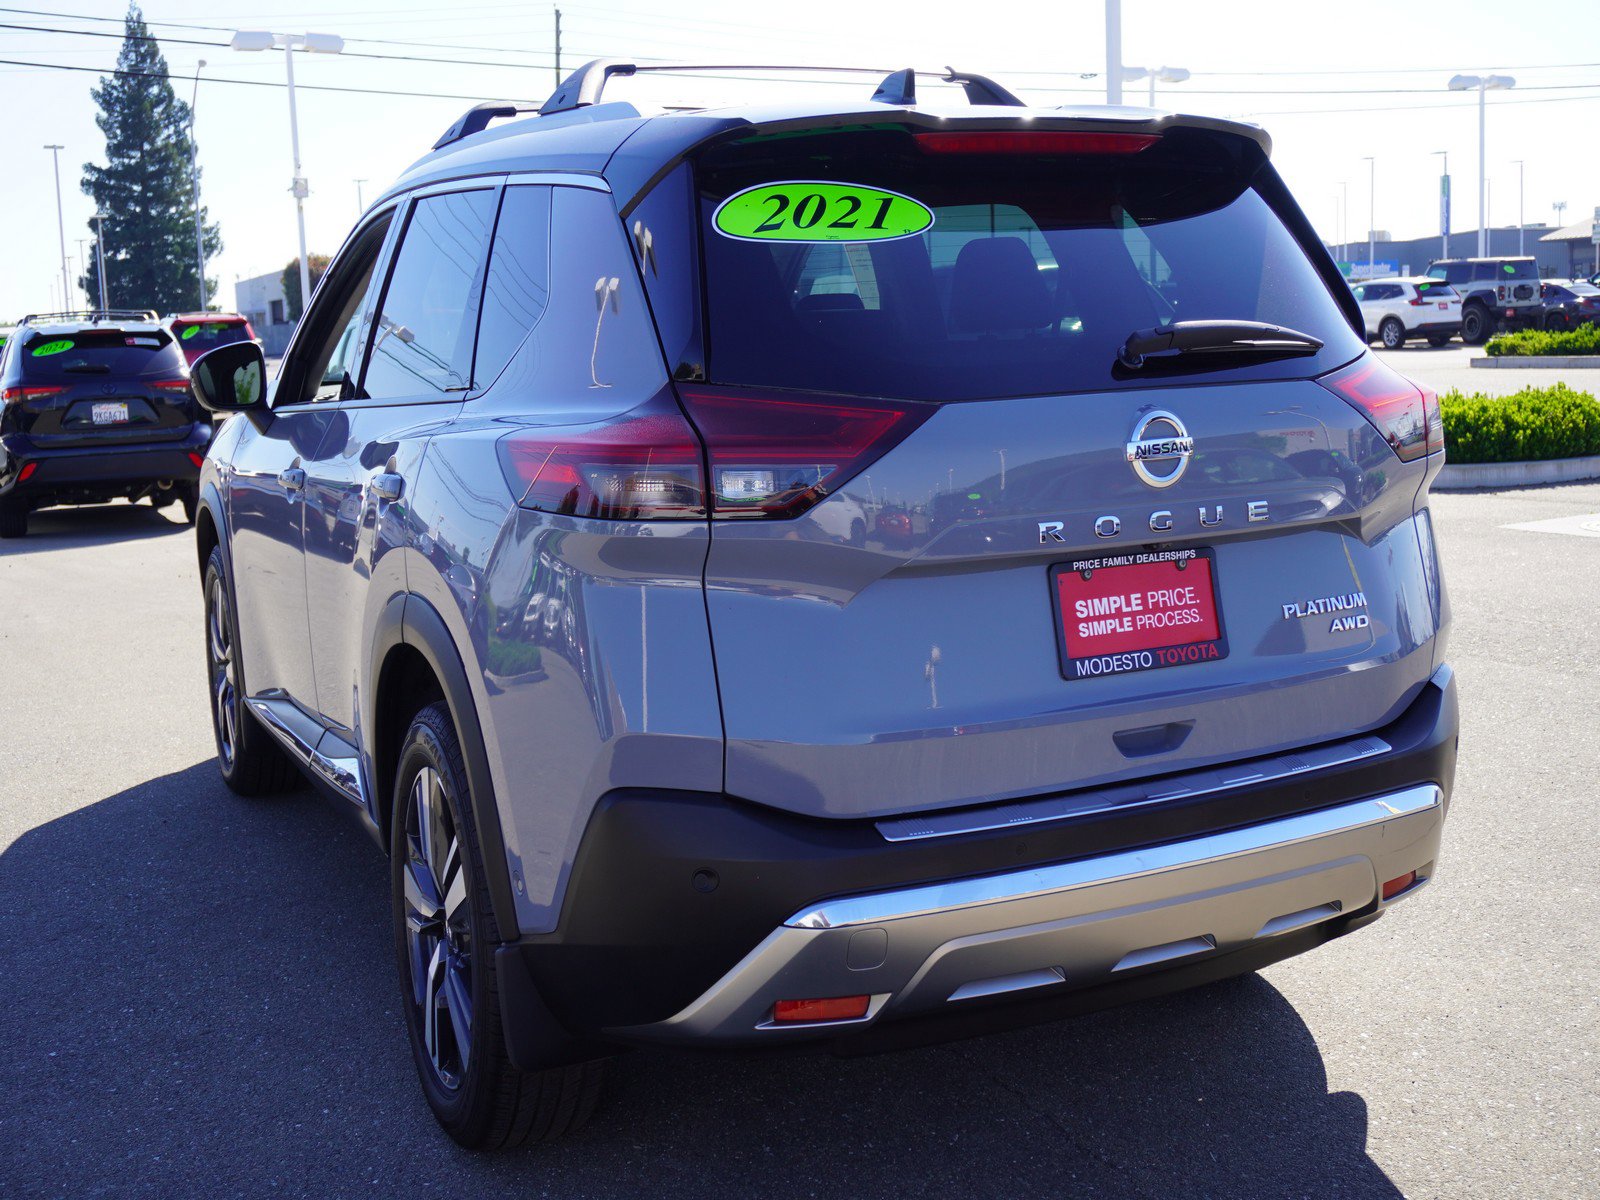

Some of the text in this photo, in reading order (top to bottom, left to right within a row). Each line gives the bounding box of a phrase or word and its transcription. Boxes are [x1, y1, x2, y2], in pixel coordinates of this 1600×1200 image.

[752, 193, 894, 234] 2021
[1135, 441, 1188, 457] NISSAN
[1037, 500, 1269, 544] ROGUE
[1073, 549, 1196, 571] PRICE FAMILY DEALERSHIPS
[1075, 586, 1200, 619] SIMPLE PRICE.
[1282, 592, 1368, 620] PLATINUM
[1078, 608, 1203, 638] SIMPLE PROCESS.
[1329, 614, 1369, 633] AWD
[1076, 643, 1219, 677] MODESTO TOYOTA
